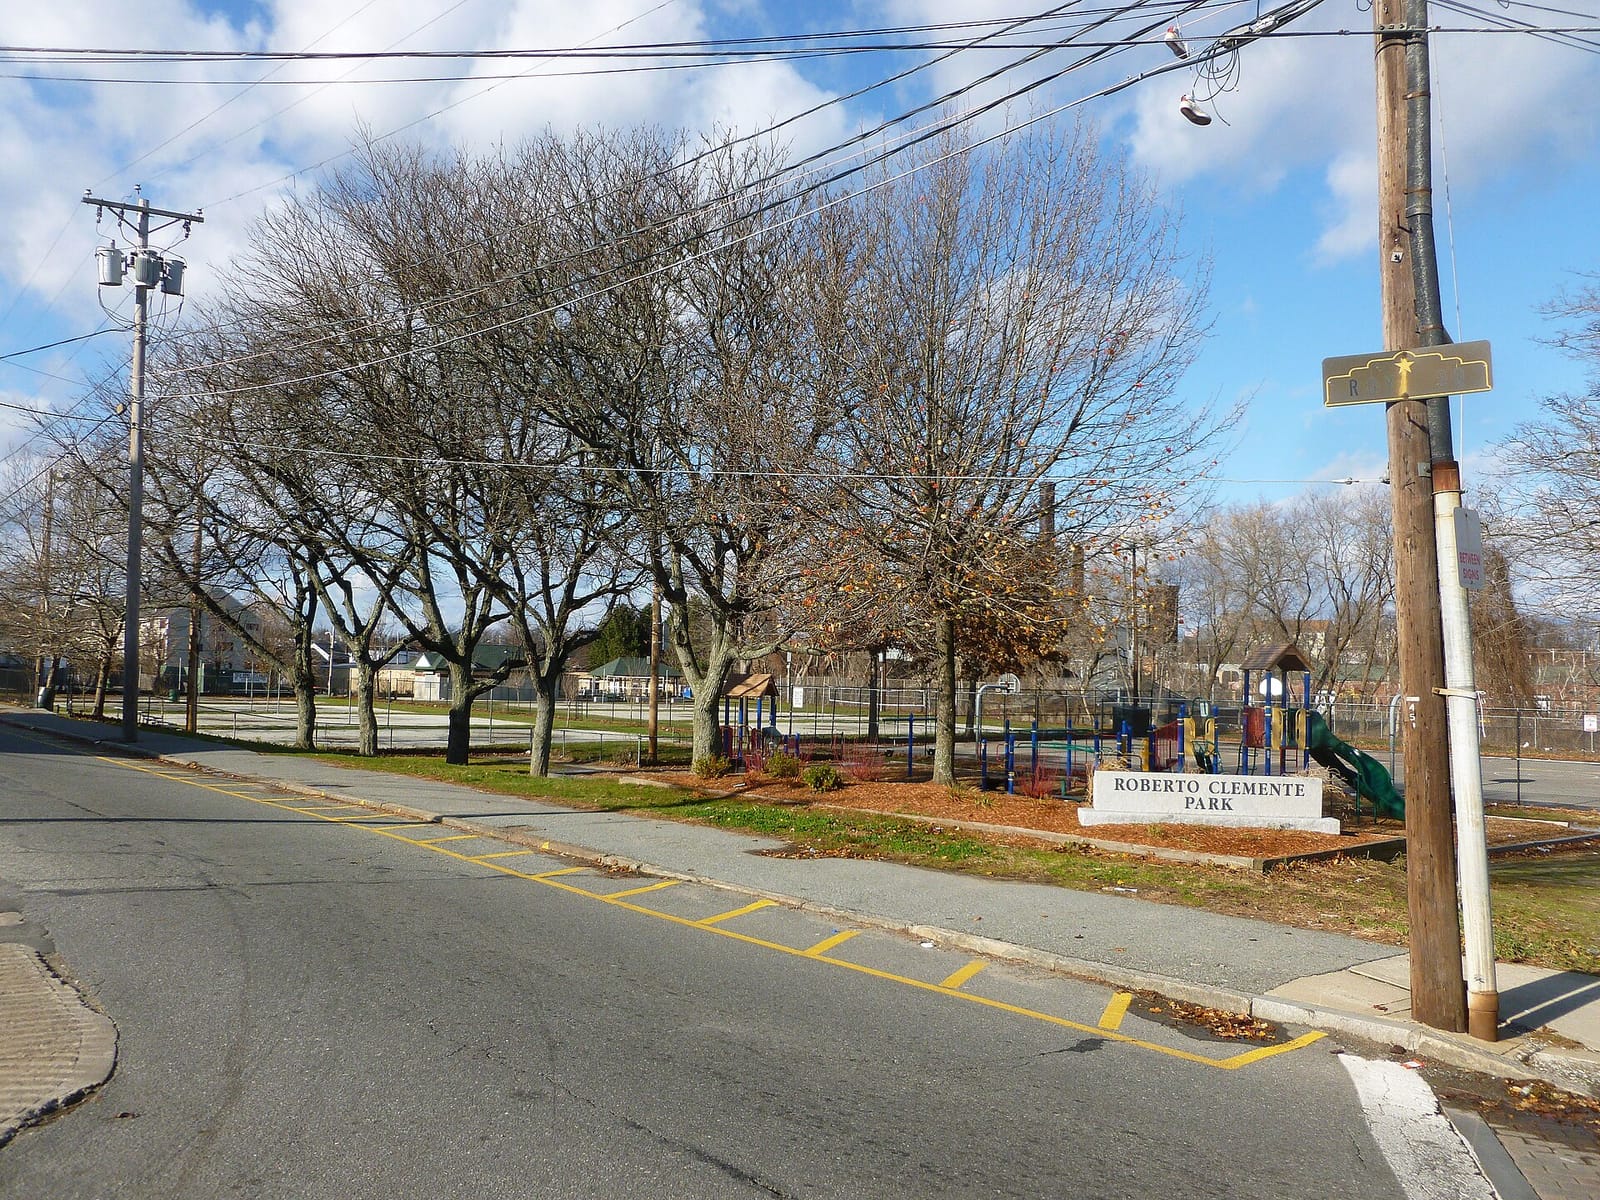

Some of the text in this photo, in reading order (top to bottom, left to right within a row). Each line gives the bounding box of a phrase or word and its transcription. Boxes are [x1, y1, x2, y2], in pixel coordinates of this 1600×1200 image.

[1463, 567, 1480, 580] SIGNS
[1114, 777, 1305, 797] ROBERTO CLEMENTE
[1184, 797, 1233, 811] PARK
